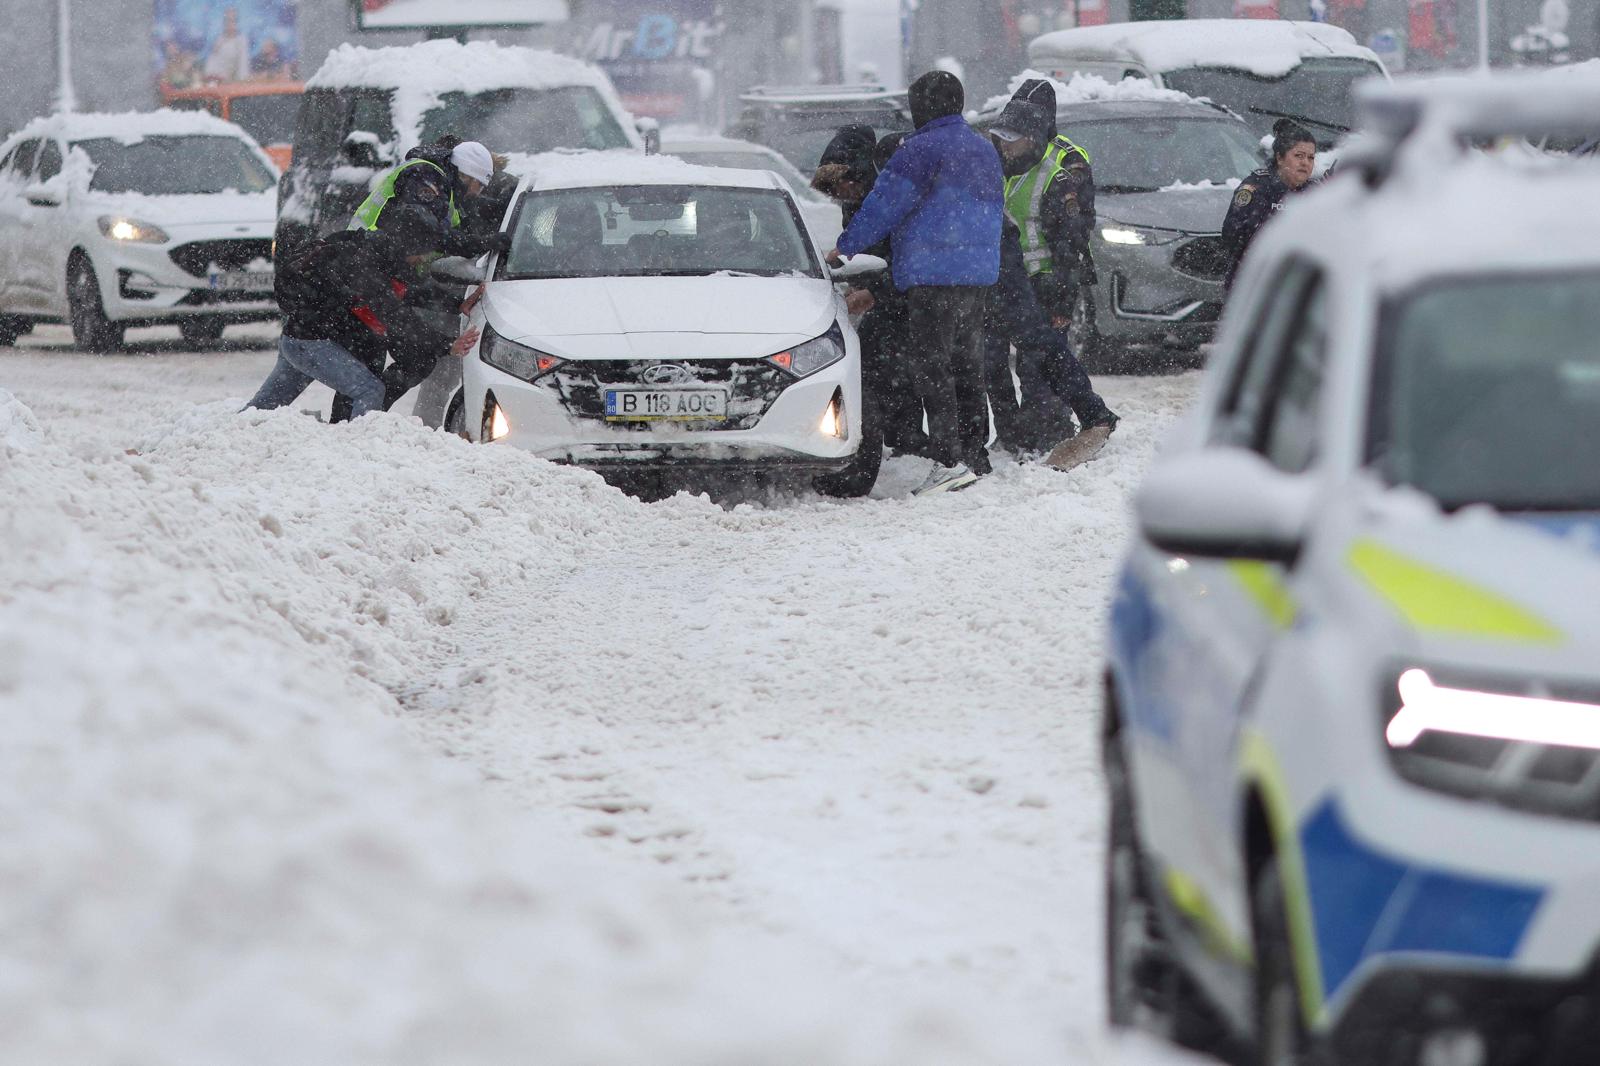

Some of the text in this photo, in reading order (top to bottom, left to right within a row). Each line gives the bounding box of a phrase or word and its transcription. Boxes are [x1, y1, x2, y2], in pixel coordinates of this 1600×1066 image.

[1271, 203, 1289, 211] POL
[623, 393, 637, 412] B
[645, 393, 670, 412] 118
